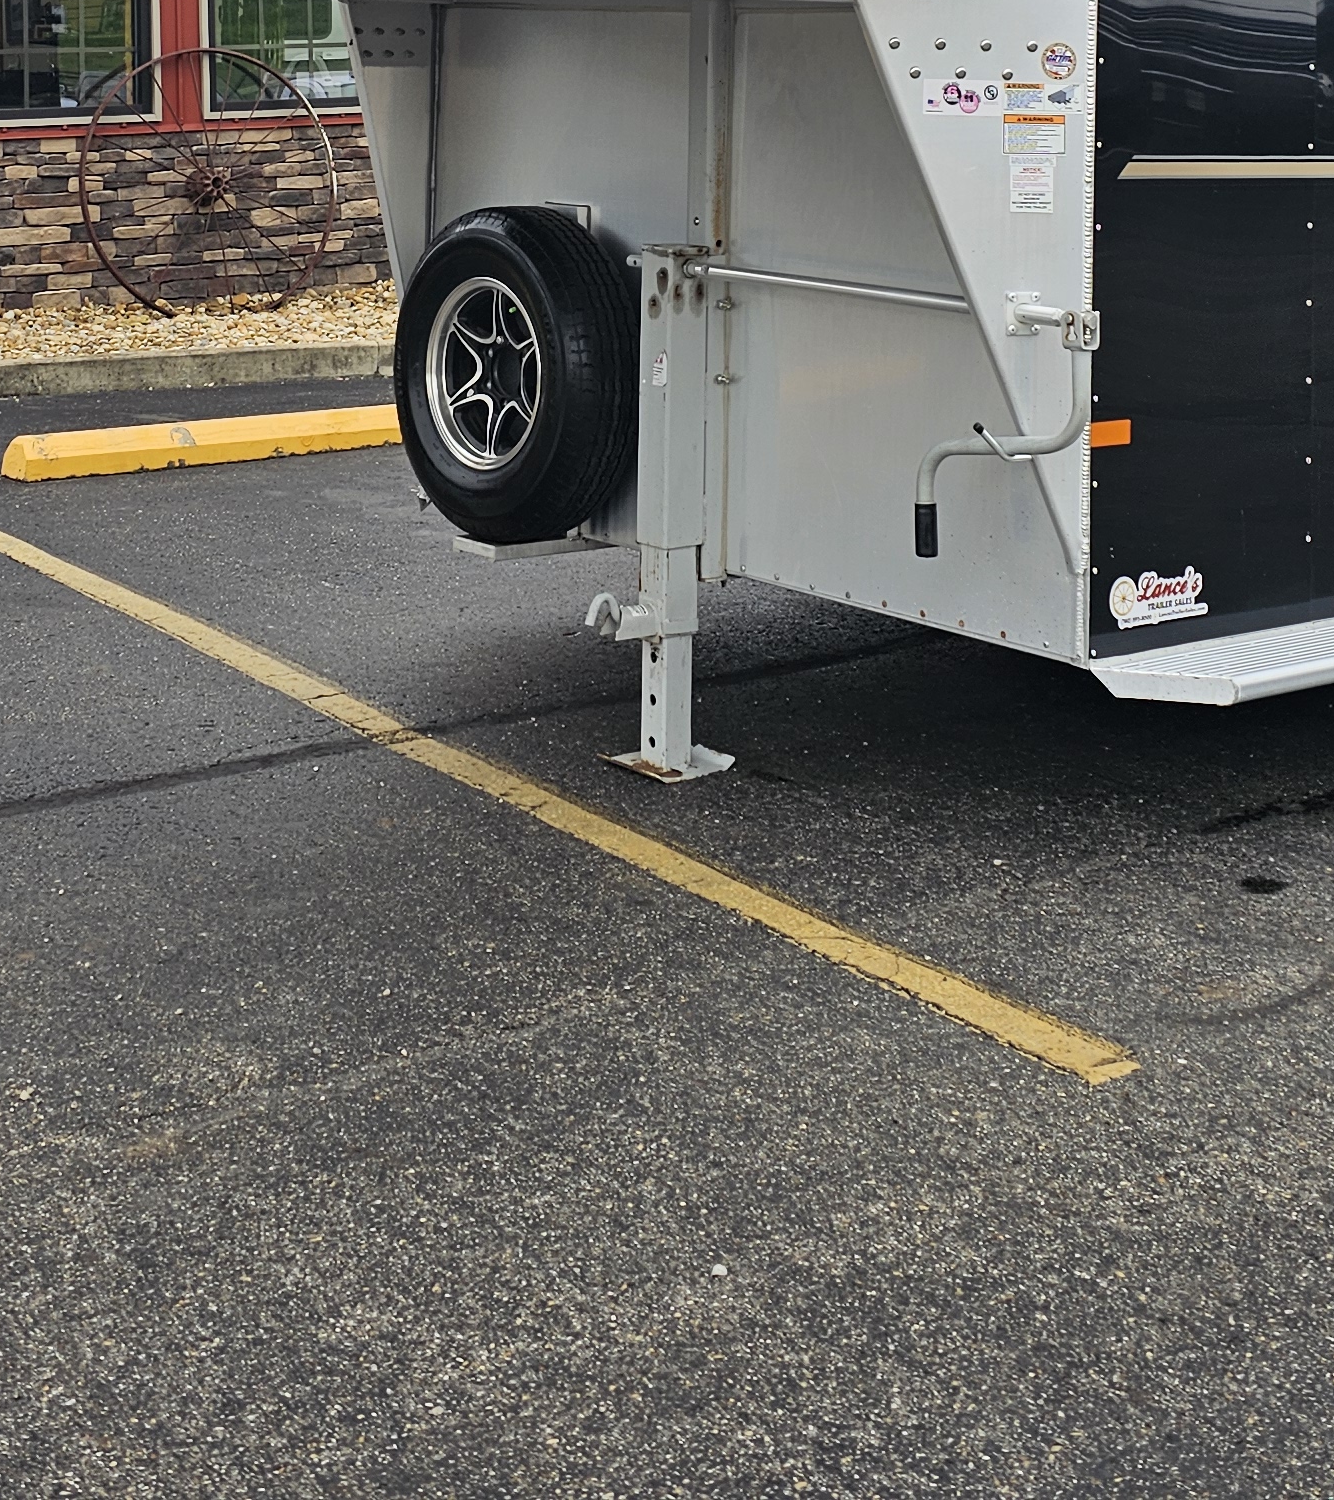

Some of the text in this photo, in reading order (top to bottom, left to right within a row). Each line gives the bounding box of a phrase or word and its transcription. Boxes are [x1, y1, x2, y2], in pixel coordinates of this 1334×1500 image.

[1136, 570, 1200, 603] Lance's
[1147, 596, 1193, 611] TRAILER SALES
